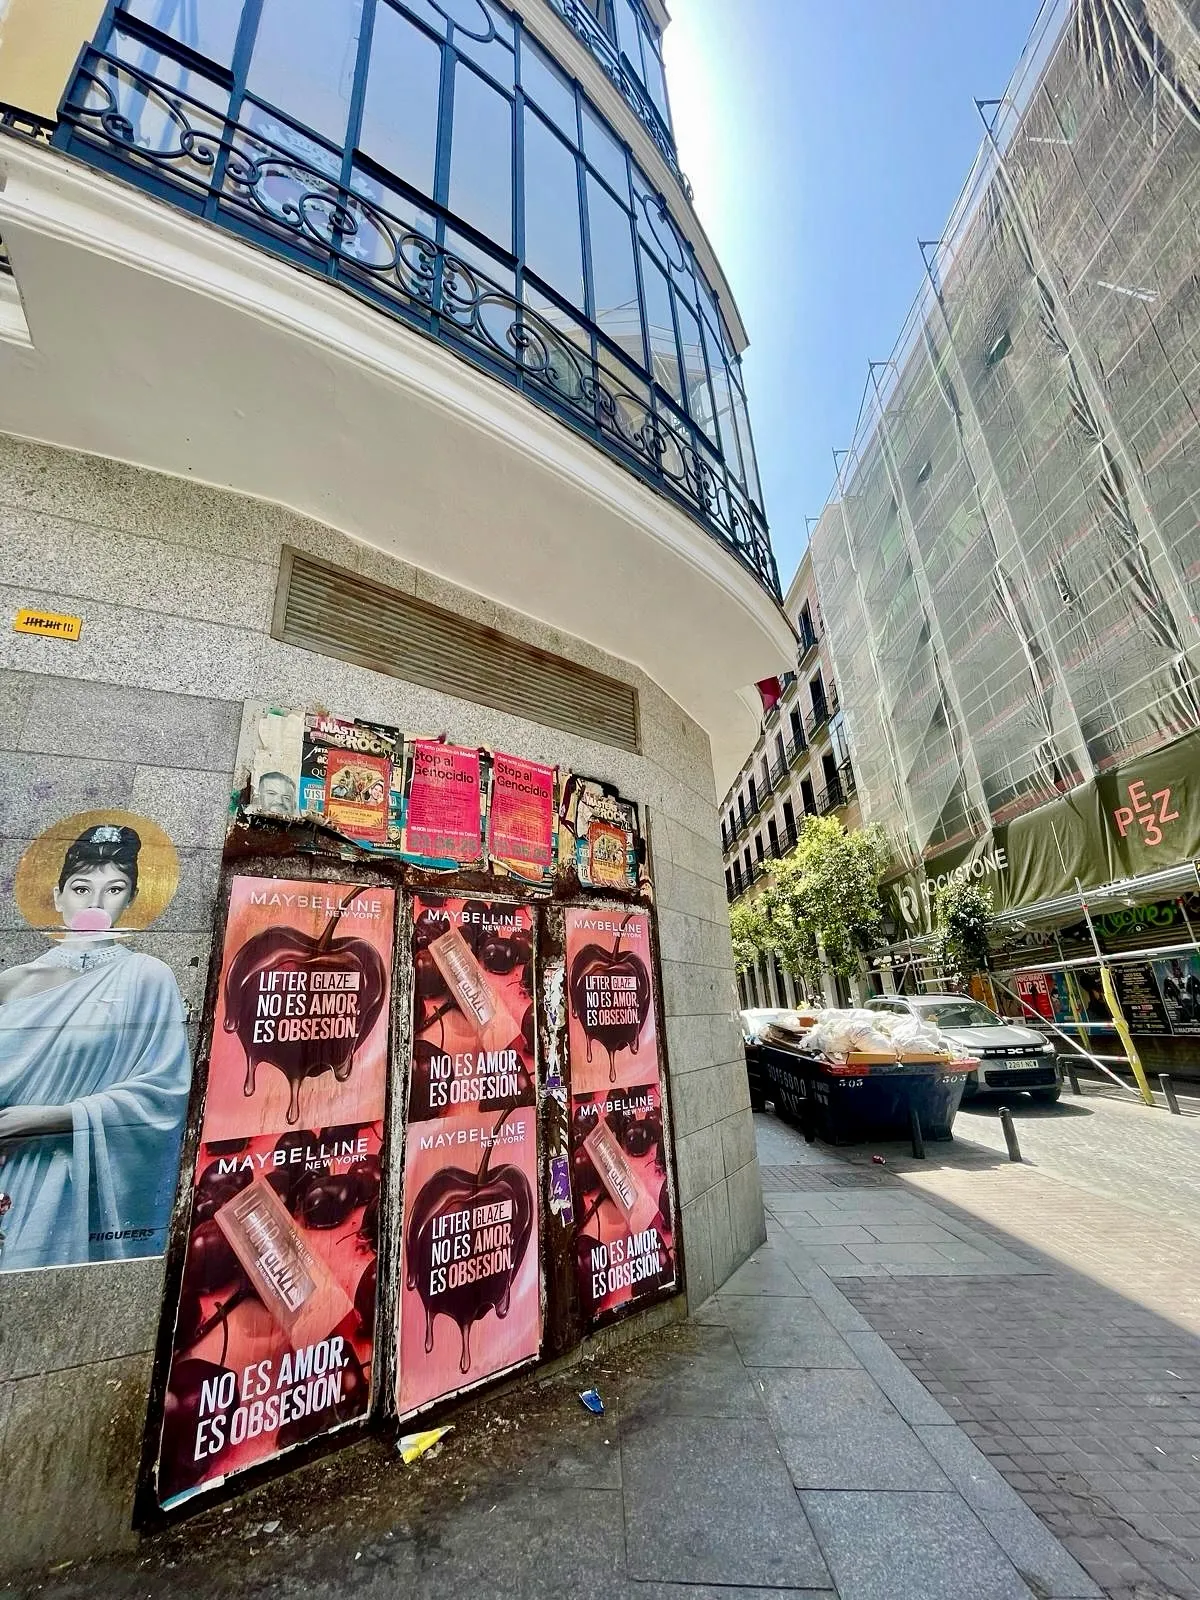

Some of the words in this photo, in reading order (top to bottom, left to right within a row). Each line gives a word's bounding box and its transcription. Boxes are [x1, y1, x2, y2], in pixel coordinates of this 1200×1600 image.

[444, 756, 454, 767] al
[497, 762, 522, 780] Stop
[523, 772, 532, 782] al
[415, 763, 474, 784] Genocidio
[497, 775, 549, 798] Genocidio
[920, 847, 1009, 899] ROCKSTONE
[250, 892, 381, 913] MAYBELLINE
[325, 910, 350, 918] NEW
[351, 911, 380, 919] YORK
[428, 909, 523, 927] MAYBELLINE
[499, 925, 522, 933] YORK
[574, 920, 641, 933] MAYBELLINE
[259, 971, 307, 992] LIFTER
[585, 975, 610, 989] LIFTER
[256, 994, 281, 1017] NO
[285, 994, 306, 1016] ES
[309, 993, 360, 1015] AMOR,
[586, 992, 598, 1008] NO
[601, 992, 611, 1007] ES
[587, 1009, 597, 1026] ES
[253, 1019, 275, 1044] ES
[278, 1014, 359, 1042] OBSESIÓN.
[430, 1055, 451, 1080] NO
[455, 1053, 472, 1077] ES
[476, 1050, 521, 1074] AMOR,
[429, 1081, 448, 1108] ES
[450, 1072, 521, 1105] OBSESIÓN.
[581, 1095, 654, 1117] MAYBELLINE
[622, 1109, 637, 1117] NEW
[637, 1106, 654, 1114] YORK
[420, 1121, 526, 1150] MAYBELLINE
[480, 1139, 501, 1149] NEW
[502, 1134, 525, 1145] YORK
[218, 1138, 368, 1175] MAYBELLINE
[305, 1158, 334, 1170] NEW
[336, 1153, 367, 1165] YORK
[432, 1210, 470, 1240] LIFTER
[431, 1239, 450, 1267] NO
[453, 1234, 471, 1260] ES
[474, 1223, 514, 1254] AMOR,
[591, 1245, 607, 1272] NO
[610, 1240, 624, 1266] ES
[430, 1267, 447, 1296] ES
[448, 1247, 514, 1288] OBSESIÓN.
[592, 1272, 607, 1299] ES
[199, 1371, 236, 1417] NO
[241, 1360, 272, 1402] ES
[277, 1335, 350, 1389] AMOR,
[194, 1414, 226, 1461] ES
[230, 1371, 346, 1446] OBSESIÓN.
